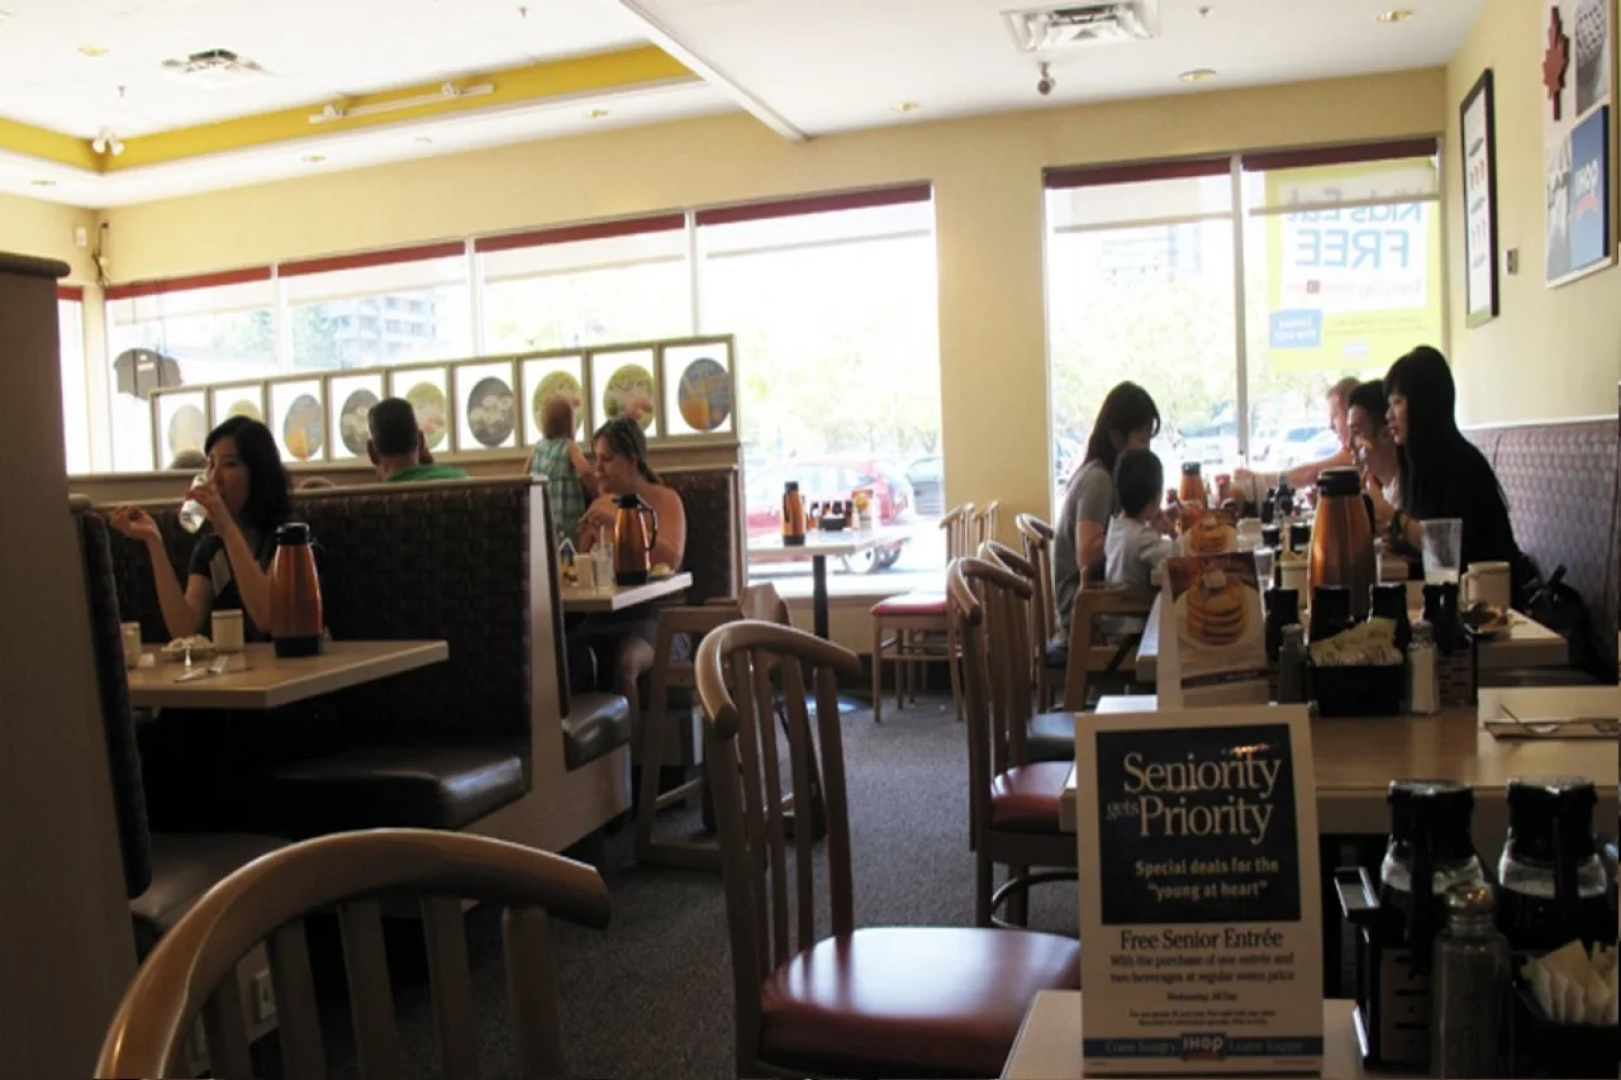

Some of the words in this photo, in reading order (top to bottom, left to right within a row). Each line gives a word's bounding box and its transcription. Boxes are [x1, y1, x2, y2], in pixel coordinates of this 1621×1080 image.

[1123, 751, 1282, 799] Seniority
[1107, 799, 1139, 820] gets
[1138, 796, 1274, 845] Priority
[1135, 859, 1186, 879] Special
[1190, 858, 1228, 874] deals
[1231, 856, 1250, 873] for
[1255, 855, 1279, 872] the
[1203, 883, 1217, 897] at
[1120, 929, 1159, 950] Free
[1162, 928, 1220, 949] Senior
[1224, 927, 1284, 948] Entrée
